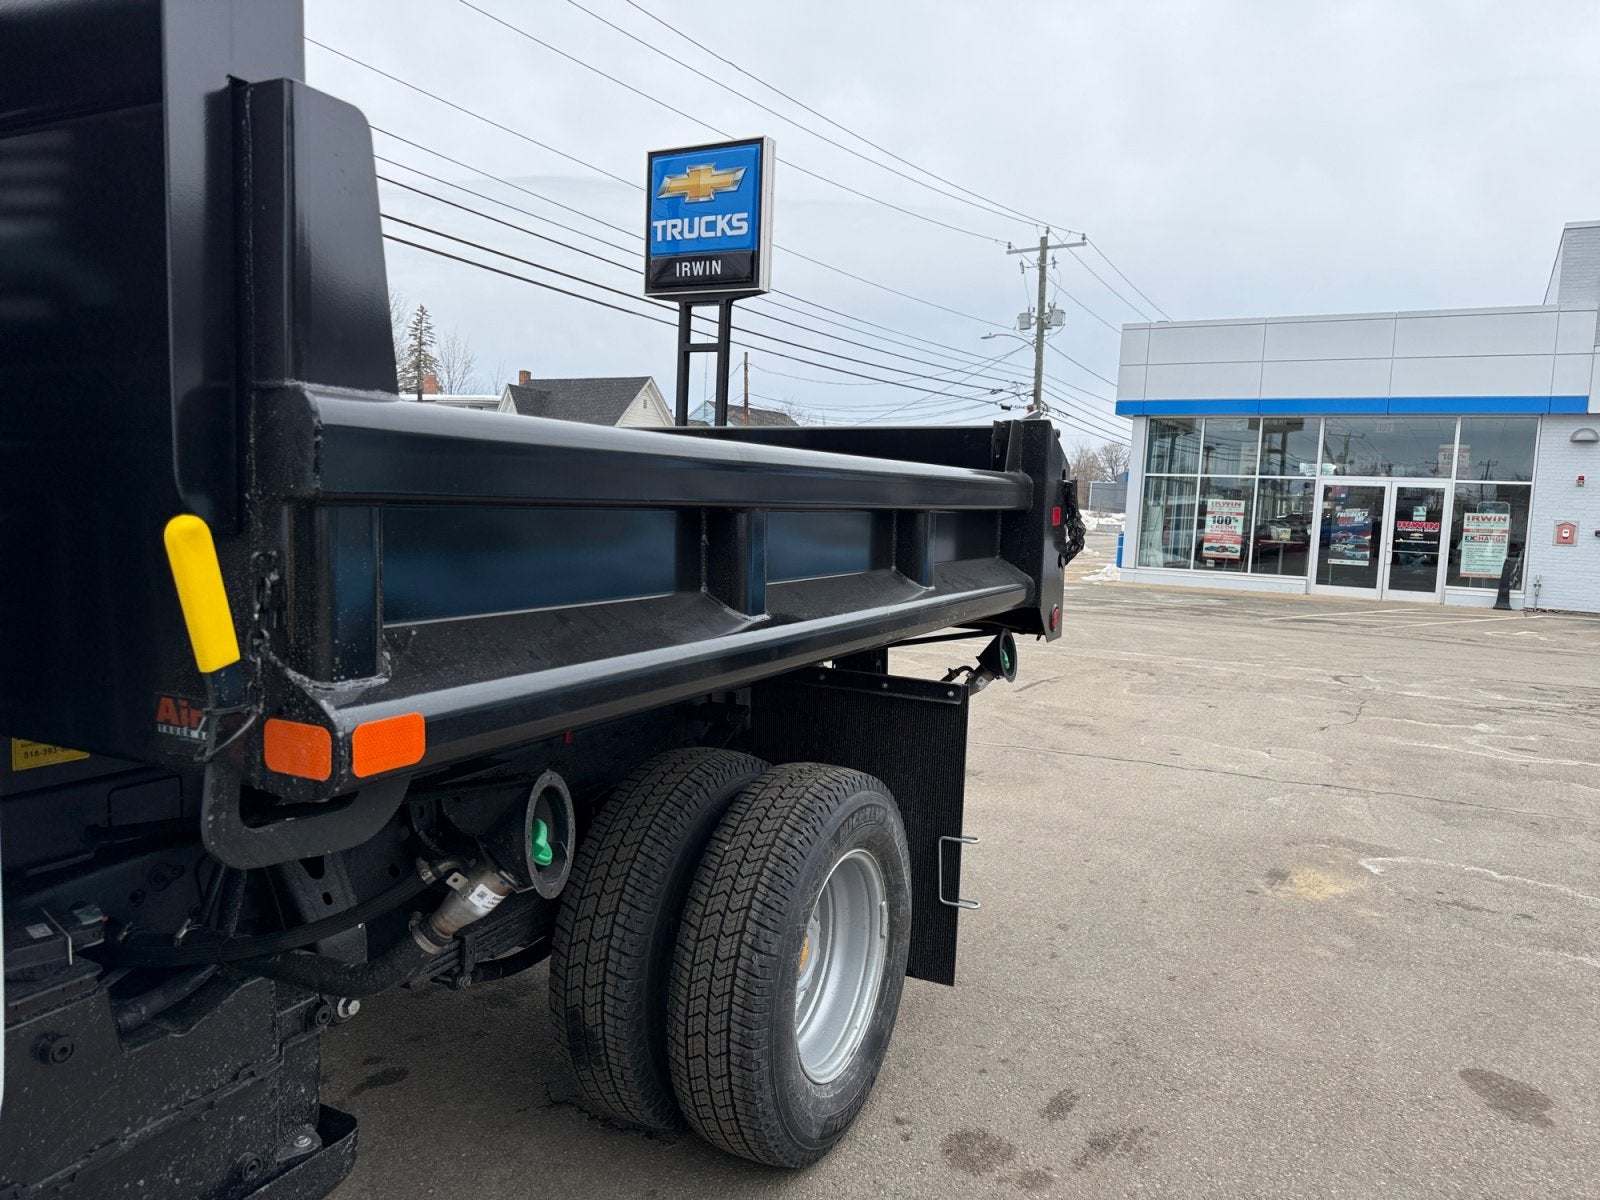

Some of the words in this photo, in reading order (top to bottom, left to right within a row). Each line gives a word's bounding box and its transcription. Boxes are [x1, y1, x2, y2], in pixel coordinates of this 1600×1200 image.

[653, 213, 749, 242] TRUCKS
[676, 260, 722, 277] IRWIN
[1210, 515, 1239, 526] 100%
[1466, 515, 1507, 523] IRWIN
[1396, 521, 1440, 530] IRWIN
[1464, 535, 1506, 543] EXCHANGE
